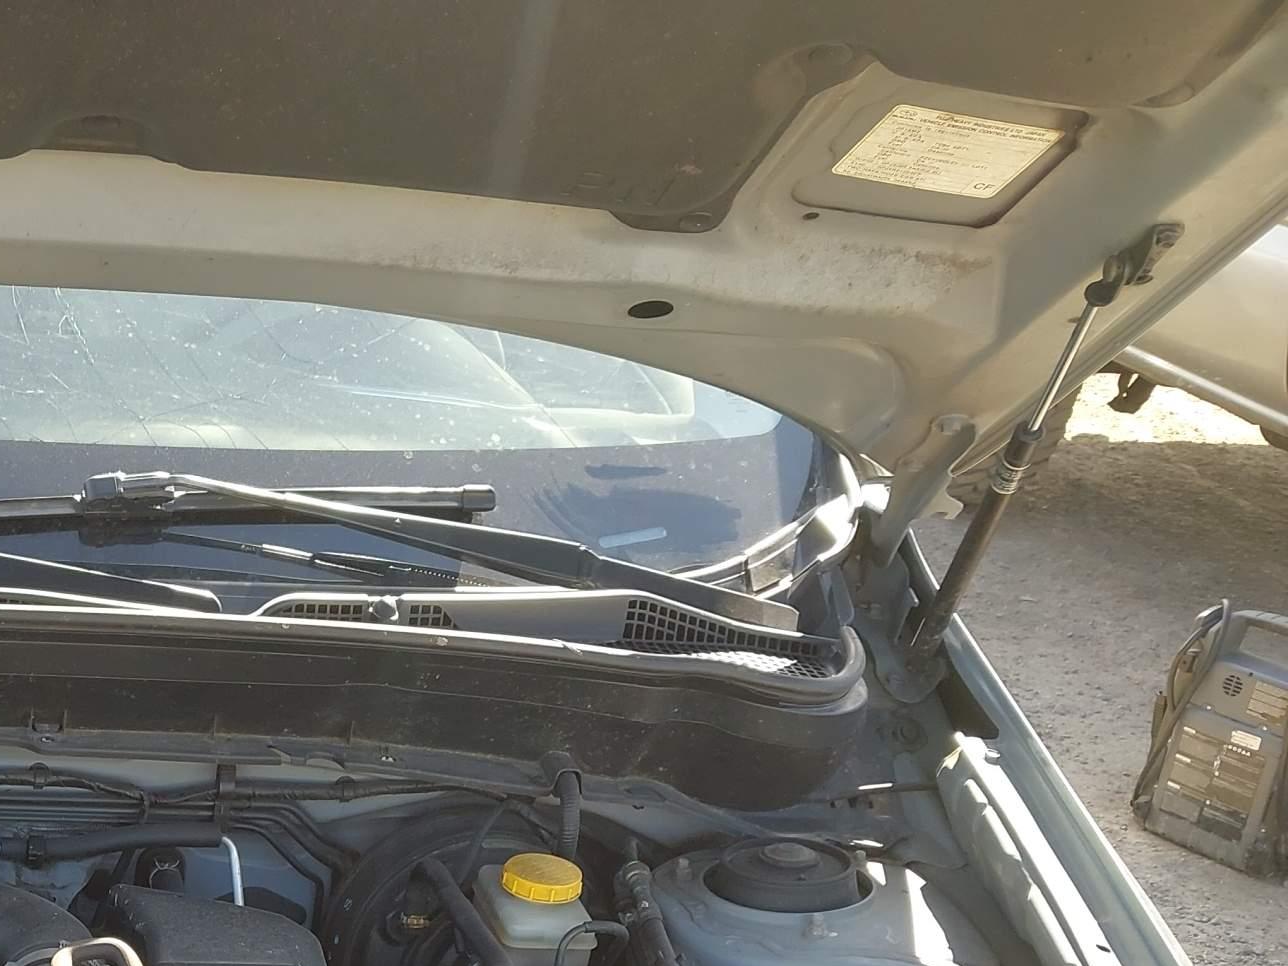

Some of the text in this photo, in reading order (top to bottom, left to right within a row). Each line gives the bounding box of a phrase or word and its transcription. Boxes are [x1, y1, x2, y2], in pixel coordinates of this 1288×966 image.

[978, 127, 1007, 138] CONTROL
[1009, 133, 1051, 143] INFORMATION
[973, 182, 995, 192] CF
